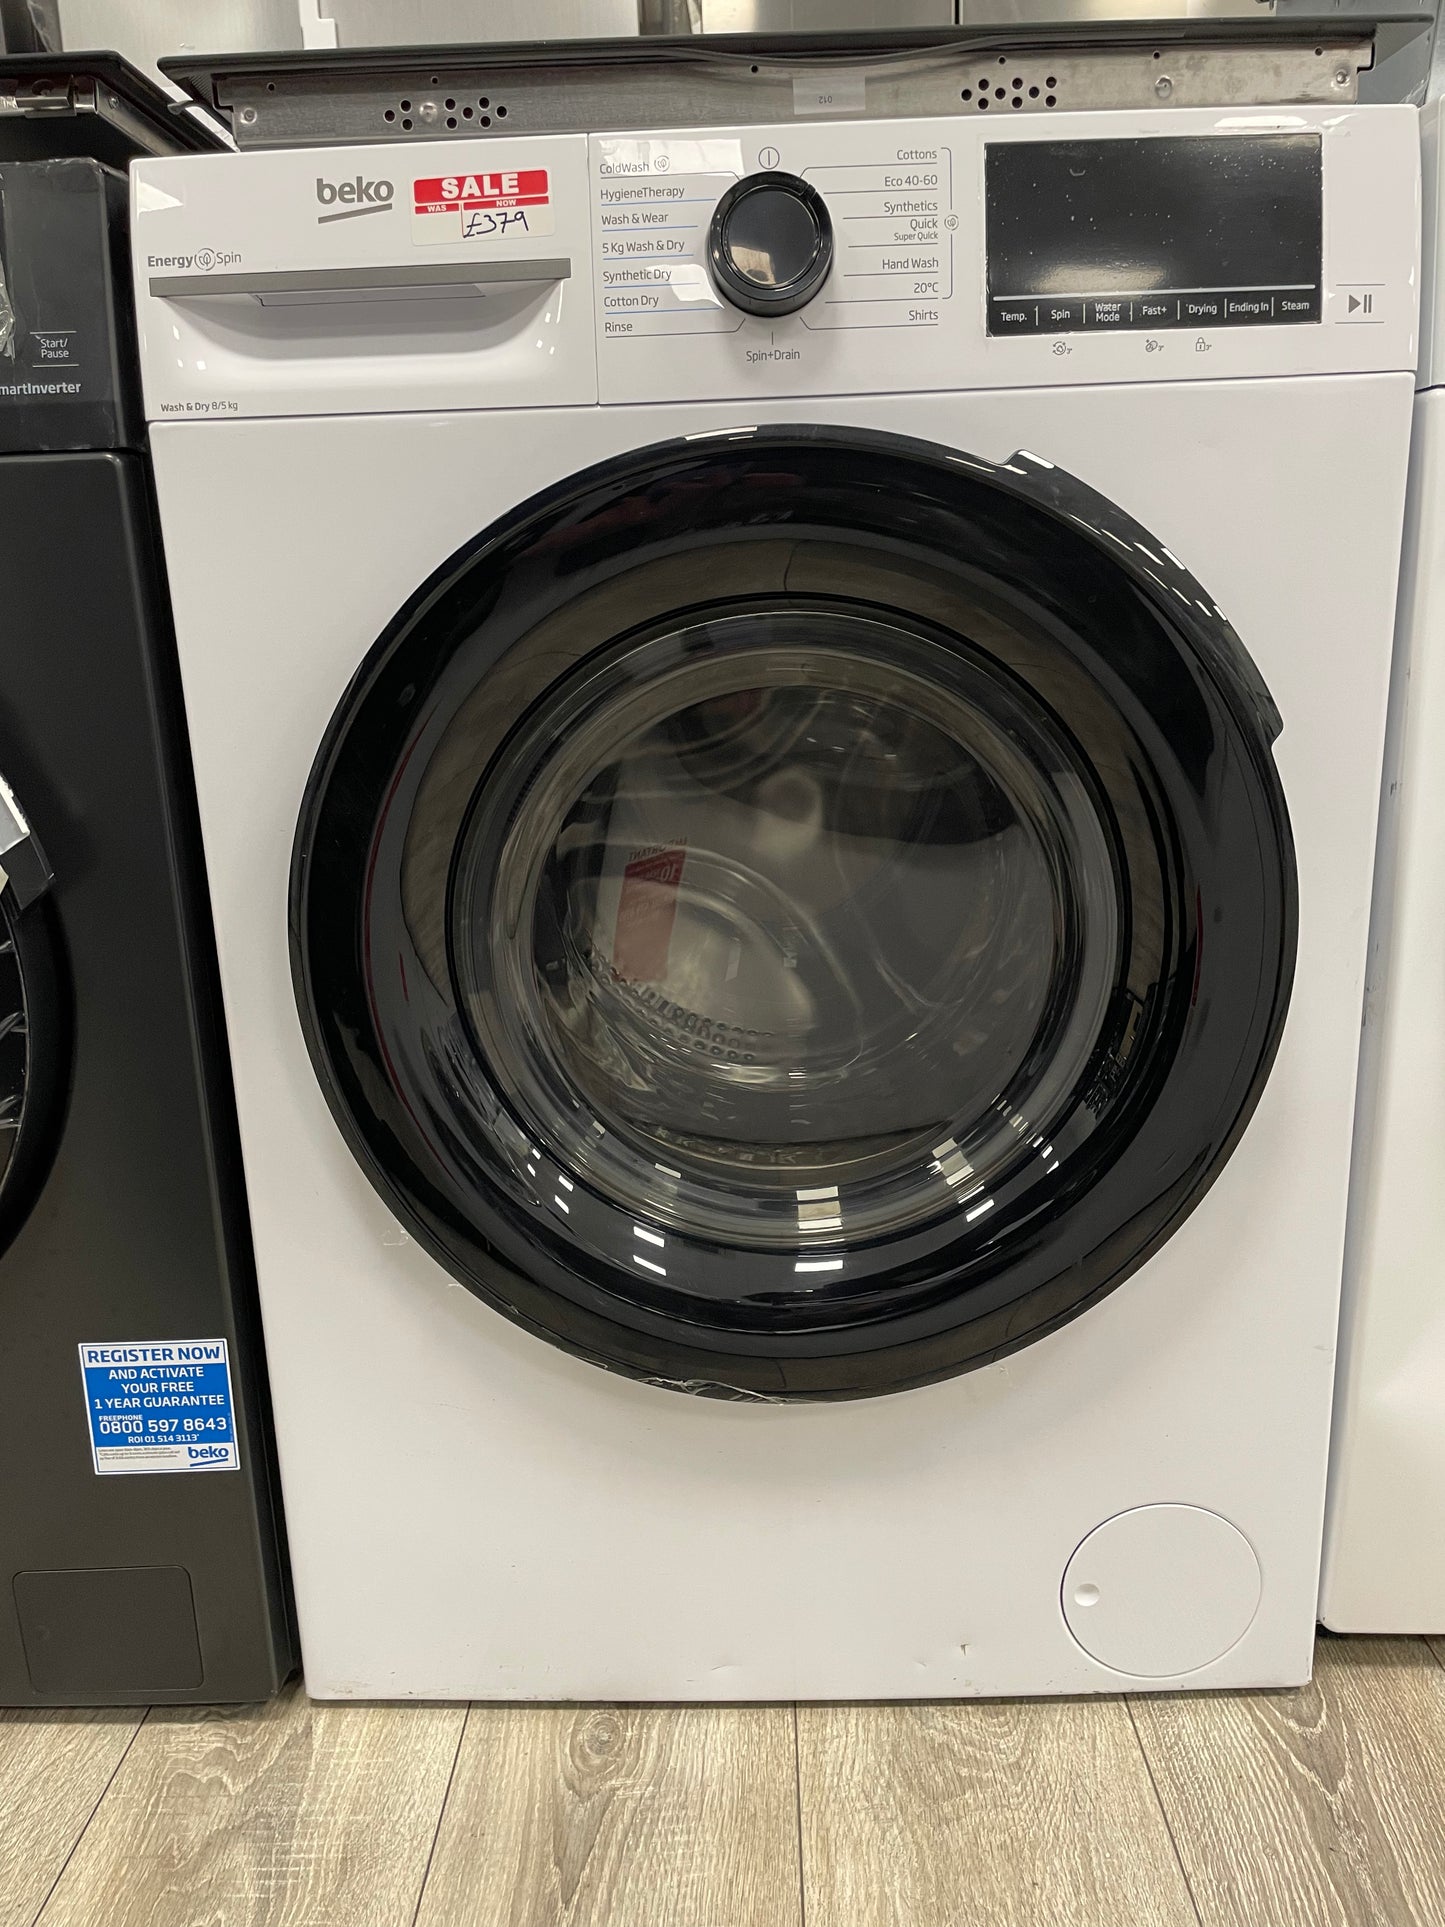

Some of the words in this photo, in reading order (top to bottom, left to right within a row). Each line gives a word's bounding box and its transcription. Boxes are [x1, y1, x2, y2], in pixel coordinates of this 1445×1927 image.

[896, 148, 938, 161] Cottons
[599, 161, 650, 175] ColdWash
[441, 172, 519, 199] SALE
[884, 176, 903, 187] Eco
[904, 174, 938, 187] 40-60
[316, 176, 394, 204] beko
[600, 185, 685, 201] HygieneTherapy
[427, 204, 447, 213] WAS
[496, 198, 517, 208] NOW
[883, 200, 938, 215] Synthetics
[462, 211, 530, 238] £379
[601, 214, 630, 226] Wash
[631, 213, 641, 225] &
[642, 212, 669, 224] Wear
[910, 217, 938, 230] Quick
[893, 231, 917, 243] Super
[918, 230, 938, 241] Quick
[602, 242, 609, 254] 5
[610, 242, 624, 256] Kg
[626, 240, 654, 252] Wash
[655, 240, 664, 251] &
[665, 239, 685, 254] Dry
[147, 253, 194, 271] Energy
[216, 250, 242, 268] Spin
[881, 257, 909, 270] Hand
[910, 256, 939, 269] Wash
[603, 268, 651, 284] Synthetic
[653, 267, 672, 283] Dry
[913, 281, 939, 294] 20°C
[604, 295, 639, 308] Cotton
[640, 294, 659, 309] Dry
[1095, 301, 1122, 313] Water
[1229, 302, 1259, 316] Ending
[1260, 301, 1269, 314] In
[1281, 300, 1310, 312] Steam
[908, 308, 939, 321] Shirts
[1051, 308, 1071, 322] Spin
[1142, 304, 1168, 316] Fast+
[1187, 302, 1218, 317] Drying
[1001, 311, 1028, 325] Temp.
[1096, 311, 1120, 323] Mode
[605, 321, 633, 333] Rinse
[40, 338, 68, 349] Start/
[41, 348, 69, 359] Pause
[745, 348, 801, 363] Spin+Drain
[0, 381, 81, 396] martInverter
[160, 403, 185, 412] Wash
[186, 402, 193, 411] &
[194, 402, 210, 412] Dry
[211, 401, 227, 411] 8/5
[228, 401, 238, 411] kg
[87, 1348, 174, 1363] REGISTER
[178, 1346, 220, 1360] NOW
[108, 1368, 138, 1379] AND
[140, 1366, 204, 1378] ACTIVATE
[121, 1382, 159, 1393] YOUR
[161, 1381, 194, 1392] FREE
[95, 1398, 103, 1409] 1
[105, 1397, 141, 1408] YEAR
[143, 1394, 225, 1407] GUARANTEE
[100, 1420, 143, 1433] 0800
[148, 1419, 179, 1432] 597
[183, 1417, 227, 1430] 8643
[128, 1435, 143, 1443] ROI
[144, 1435, 156, 1443] 01
[157, 1434, 174, 1443] 514
[187, 1446, 229, 1459] beko
